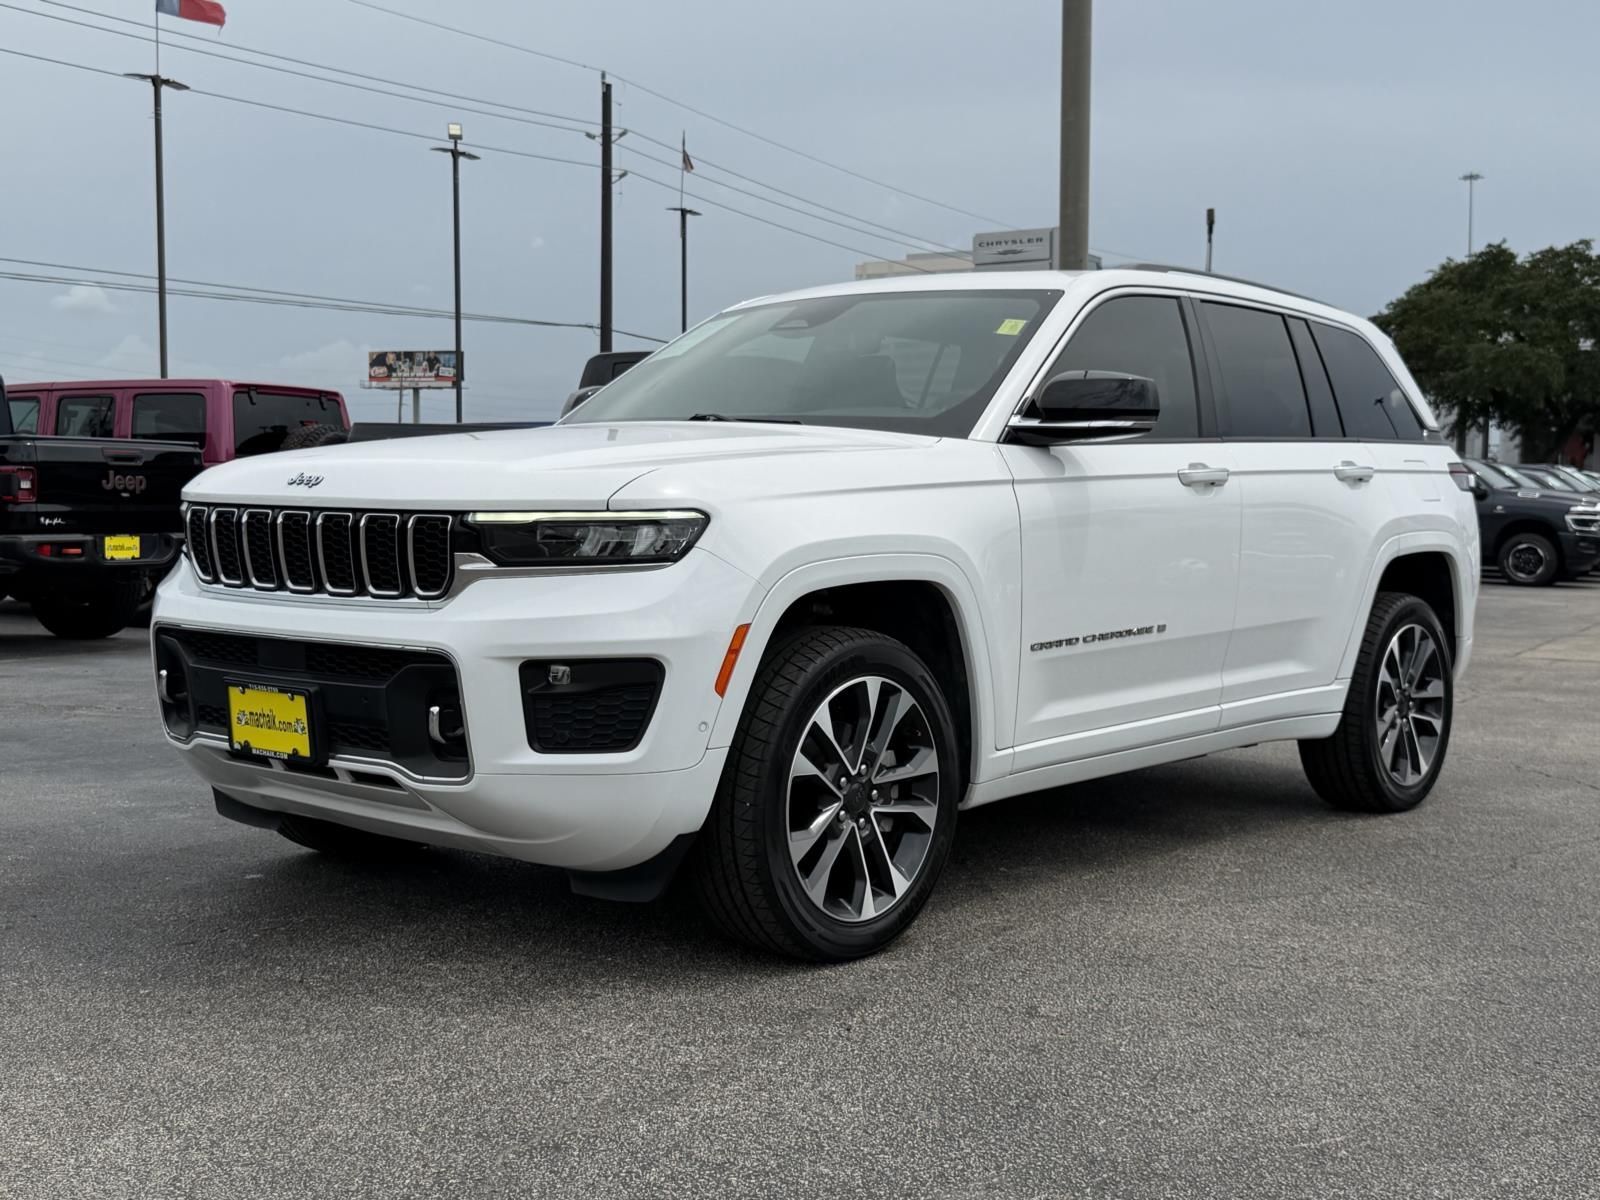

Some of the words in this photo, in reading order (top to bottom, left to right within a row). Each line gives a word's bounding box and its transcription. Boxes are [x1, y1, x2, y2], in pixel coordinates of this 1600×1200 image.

[978, 237, 1043, 248] CHRYSLER
[101, 470, 147, 494] Jeep
[287, 472, 324, 488] Jeep
[1030, 637, 1080, 652] GRAND
[1082, 625, 1155, 644] CHEROKEE
